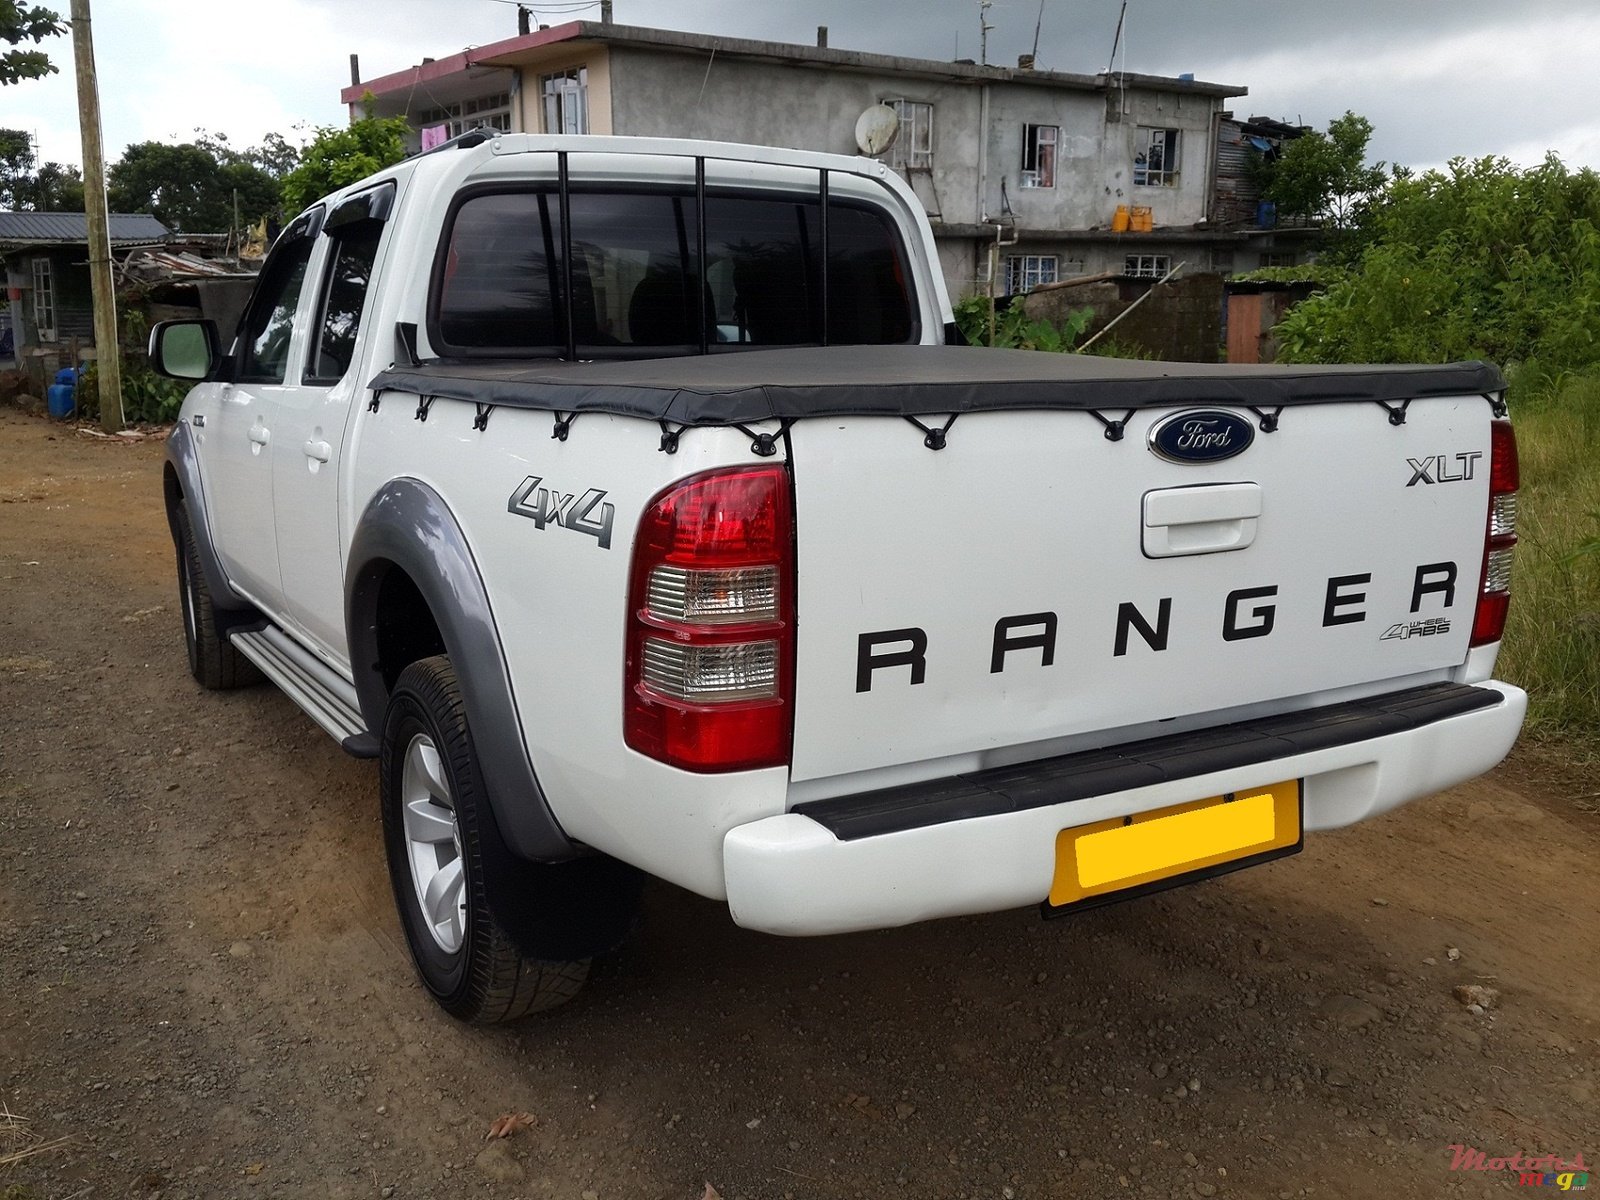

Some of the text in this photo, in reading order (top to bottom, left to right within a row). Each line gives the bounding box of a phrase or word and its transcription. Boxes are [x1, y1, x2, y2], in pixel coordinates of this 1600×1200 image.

[1177, 419, 1232, 449] Ford
[1405, 451, 1482, 487] XLT
[507, 475, 615, 550] 4x4
[856, 561, 1458, 693] RANGER
[1409, 617, 1451, 628] WHEEL
